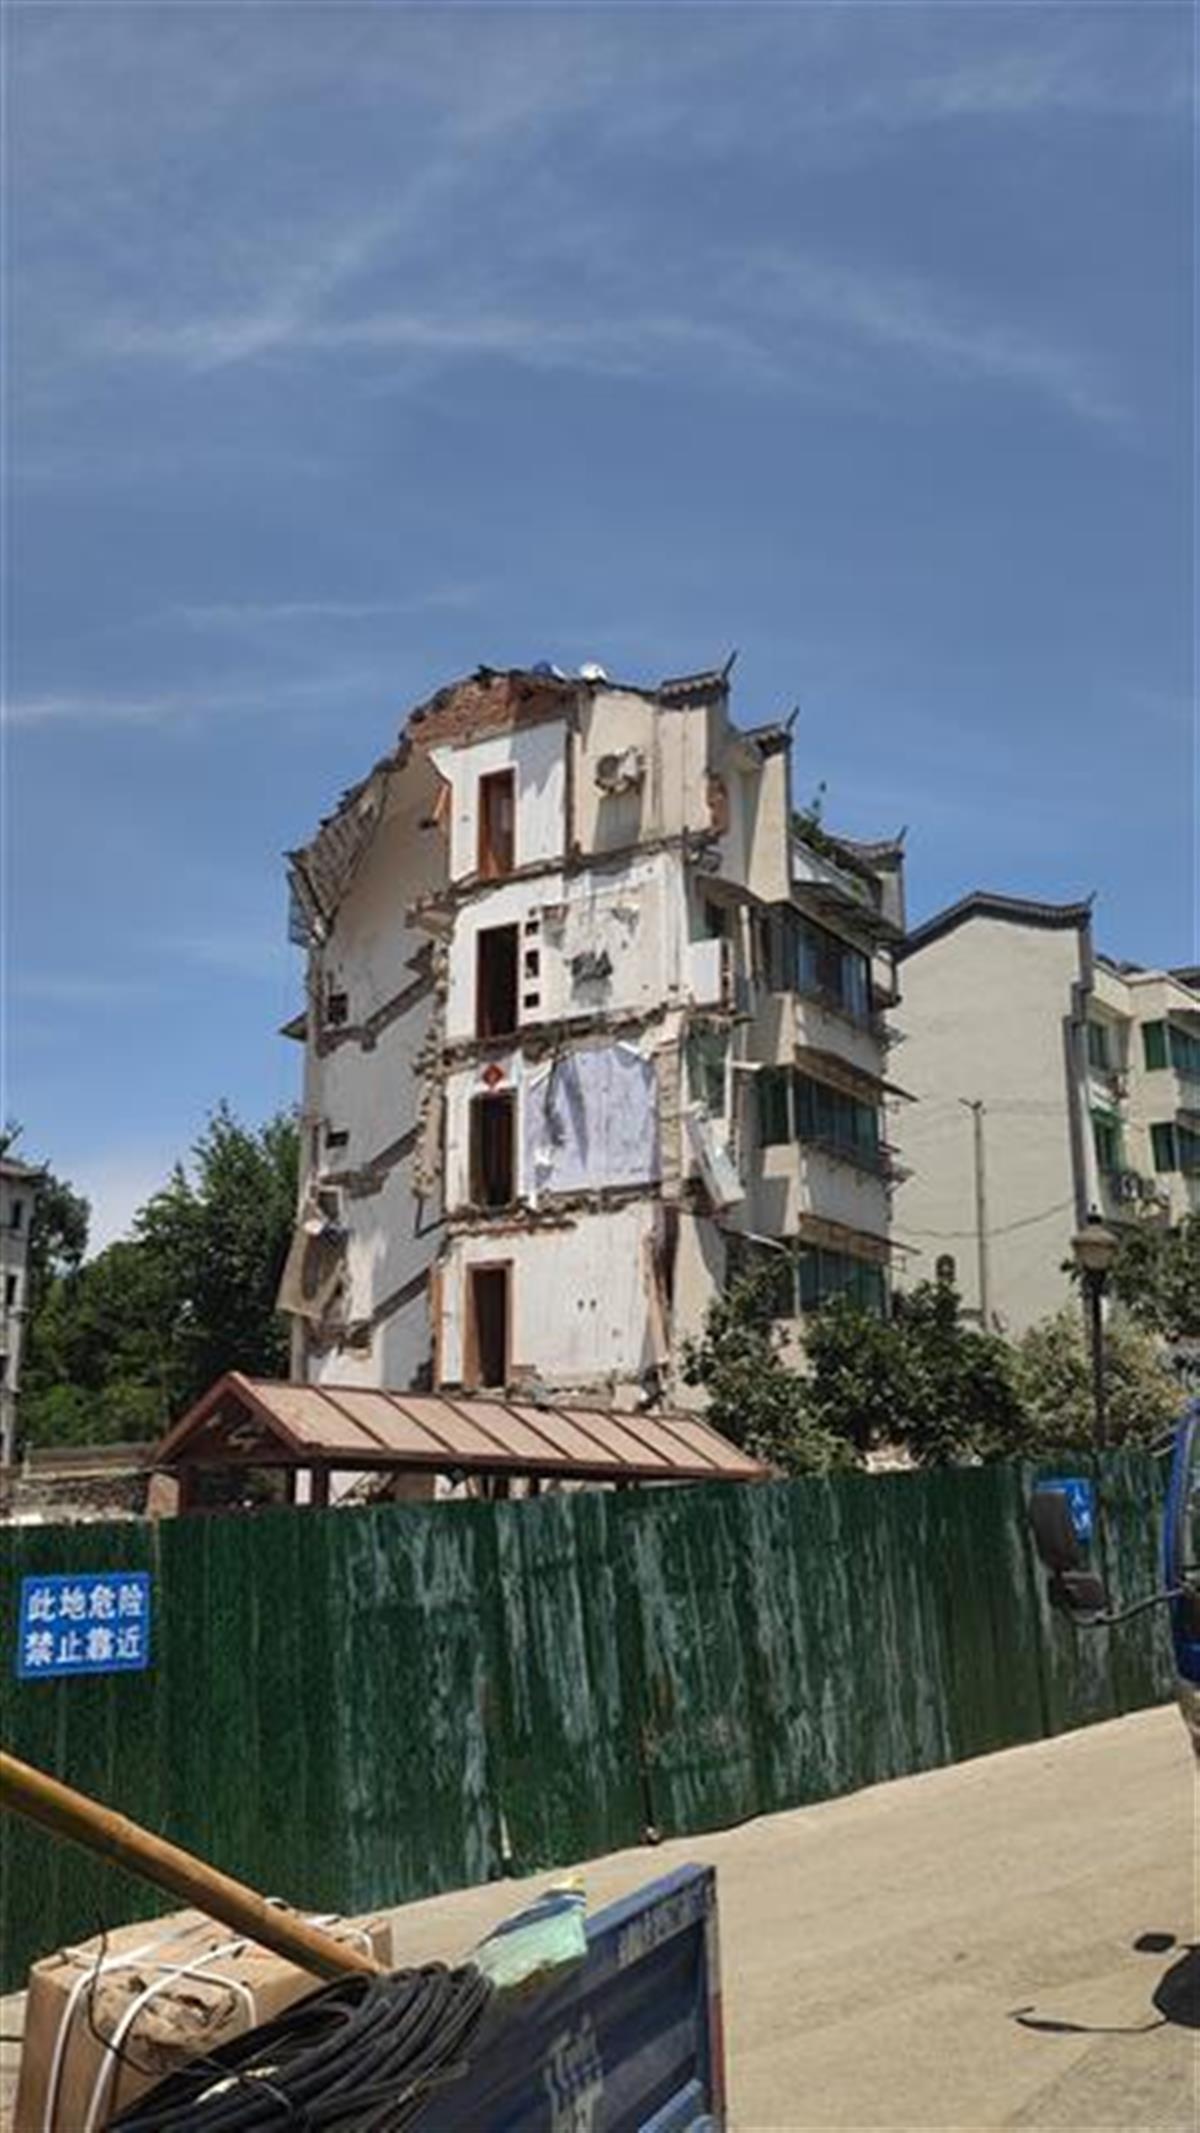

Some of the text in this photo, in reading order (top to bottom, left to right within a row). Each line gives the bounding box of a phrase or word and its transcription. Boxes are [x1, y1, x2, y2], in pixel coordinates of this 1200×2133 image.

[28, 1584, 144, 1621] 此地危险
[24, 1625, 141, 1667] 禁止靠近
